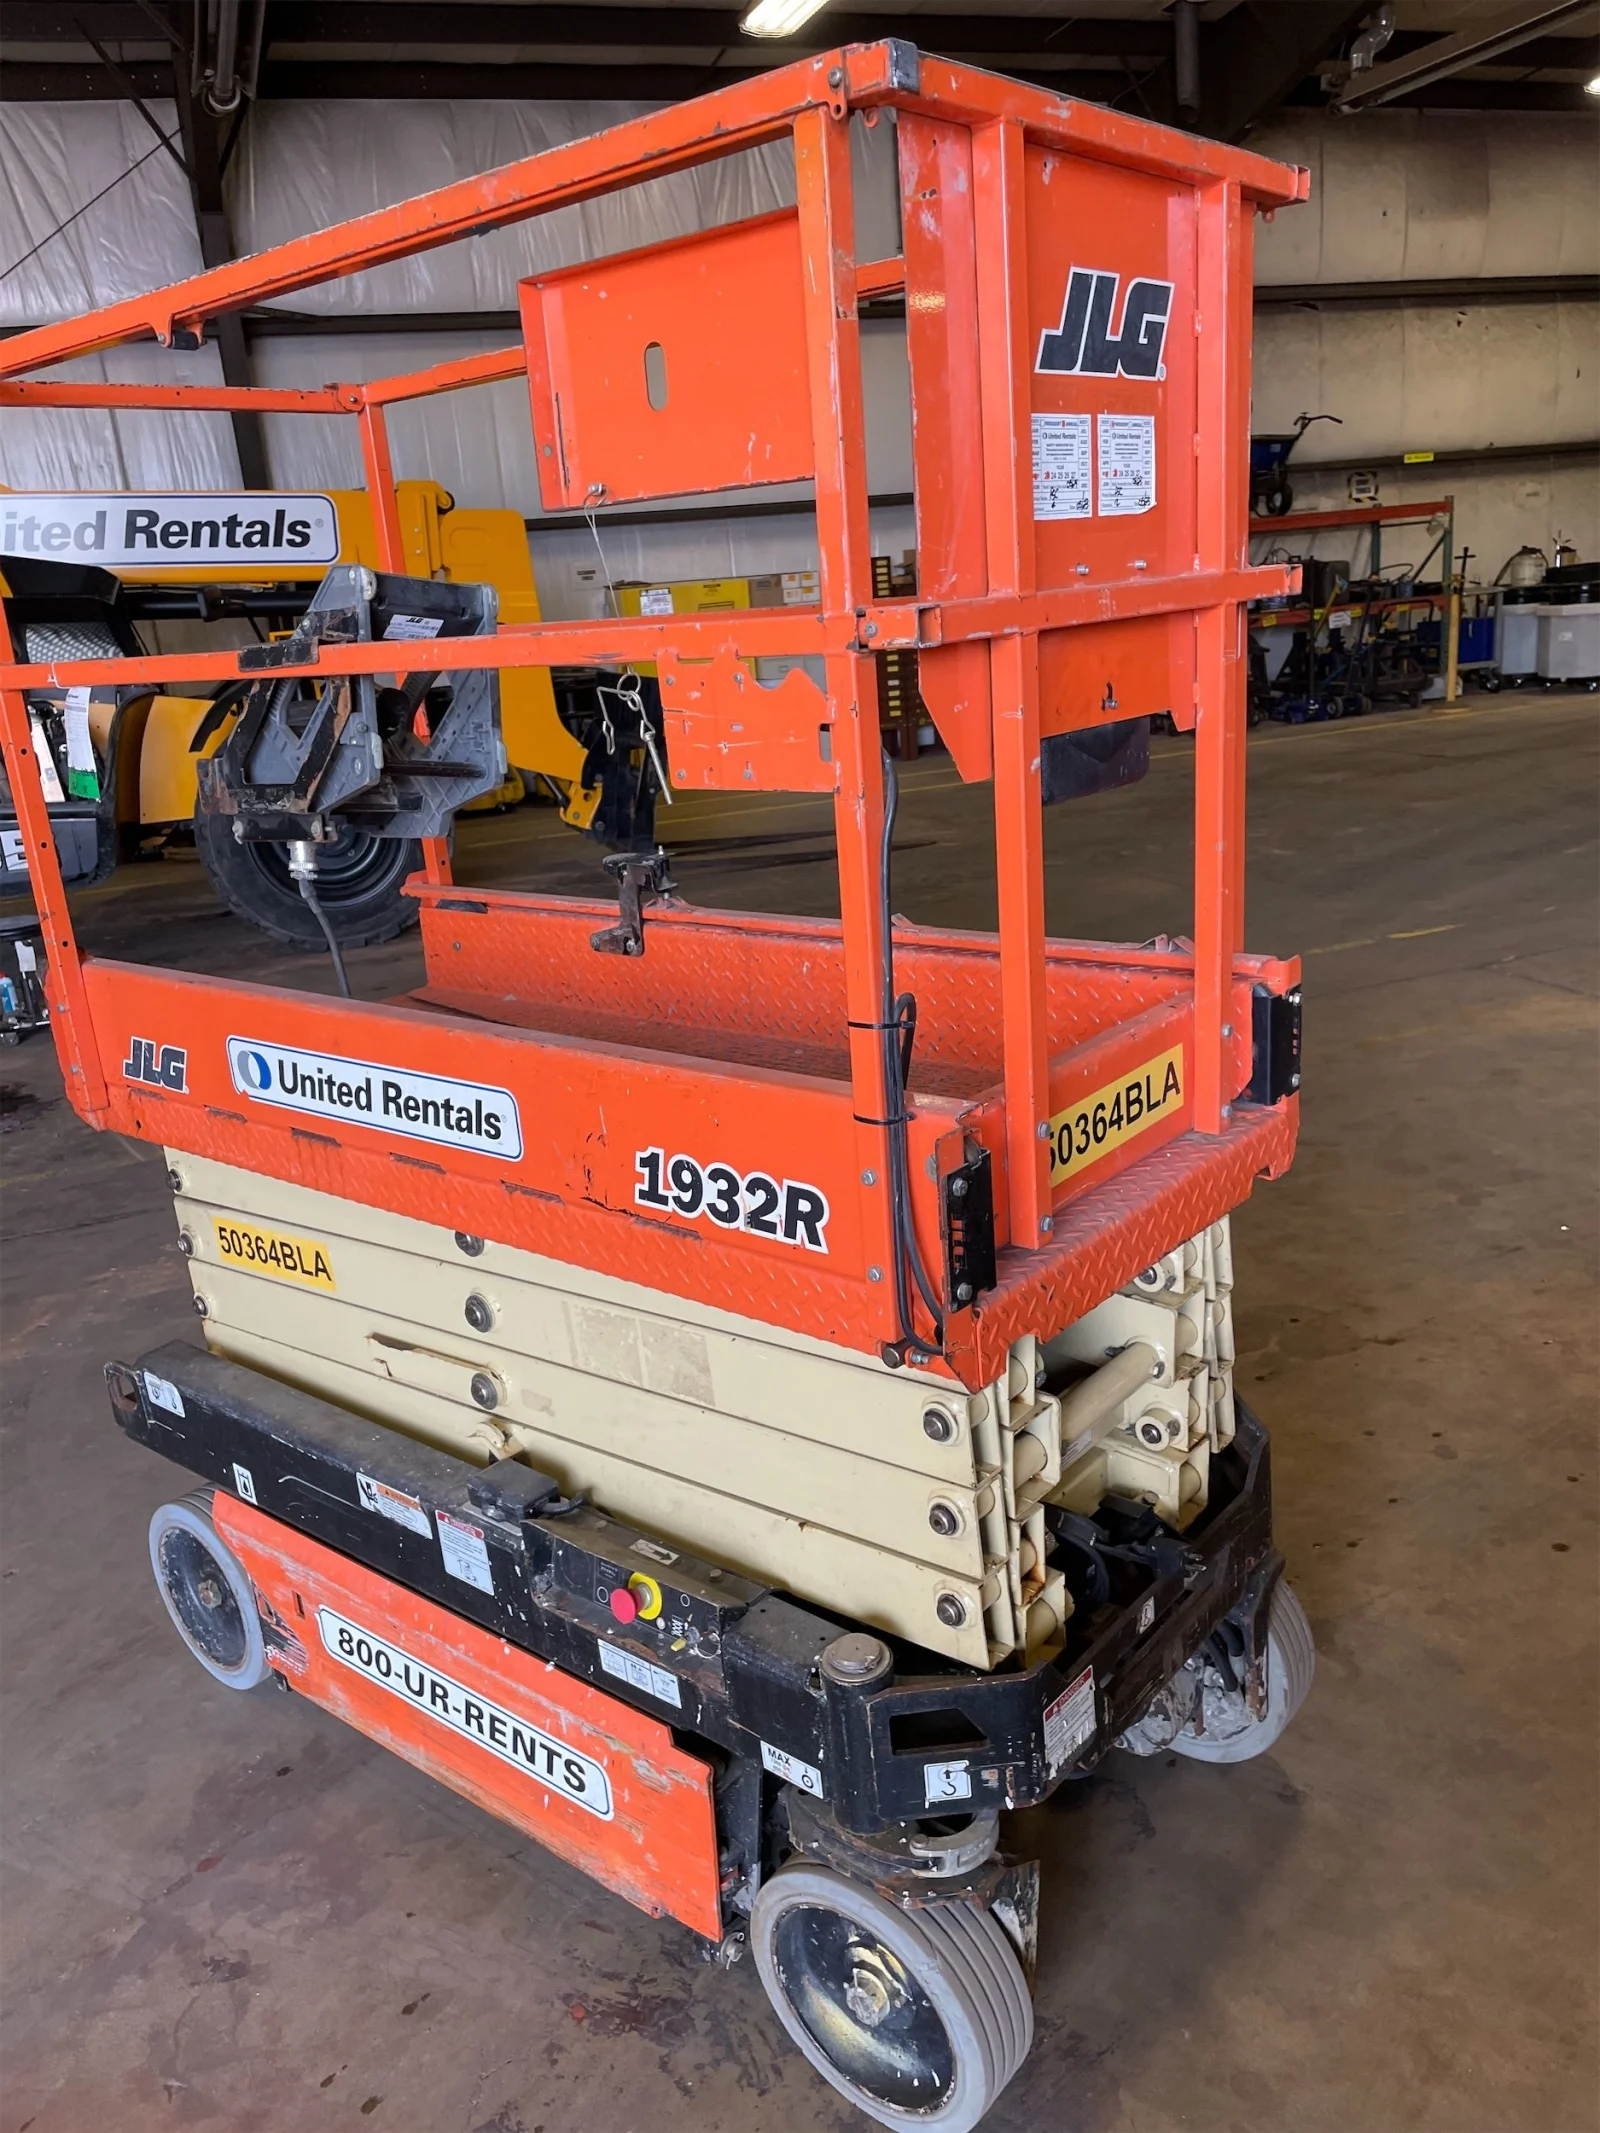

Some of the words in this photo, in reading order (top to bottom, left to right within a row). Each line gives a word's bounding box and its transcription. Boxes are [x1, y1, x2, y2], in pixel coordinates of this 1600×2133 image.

[1036, 268, 1174, 379] JLG
[1048, 432, 1061, 440] United
[0, 510, 107, 552] ited
[124, 509, 311, 550] Rentals
[122, 1036, 188, 1094] JLG
[278, 1059, 372, 1112] United
[382, 1080, 502, 1140] Rentals
[637, 1149, 827, 1251] 1932R
[218, 1226, 332, 1281] 50364BLA
[337, 1627, 587, 1794] 800-UR-RENTS
[1059, 1676, 1085, 1707] DANGER
[767, 1747, 792, 1767] MAX
